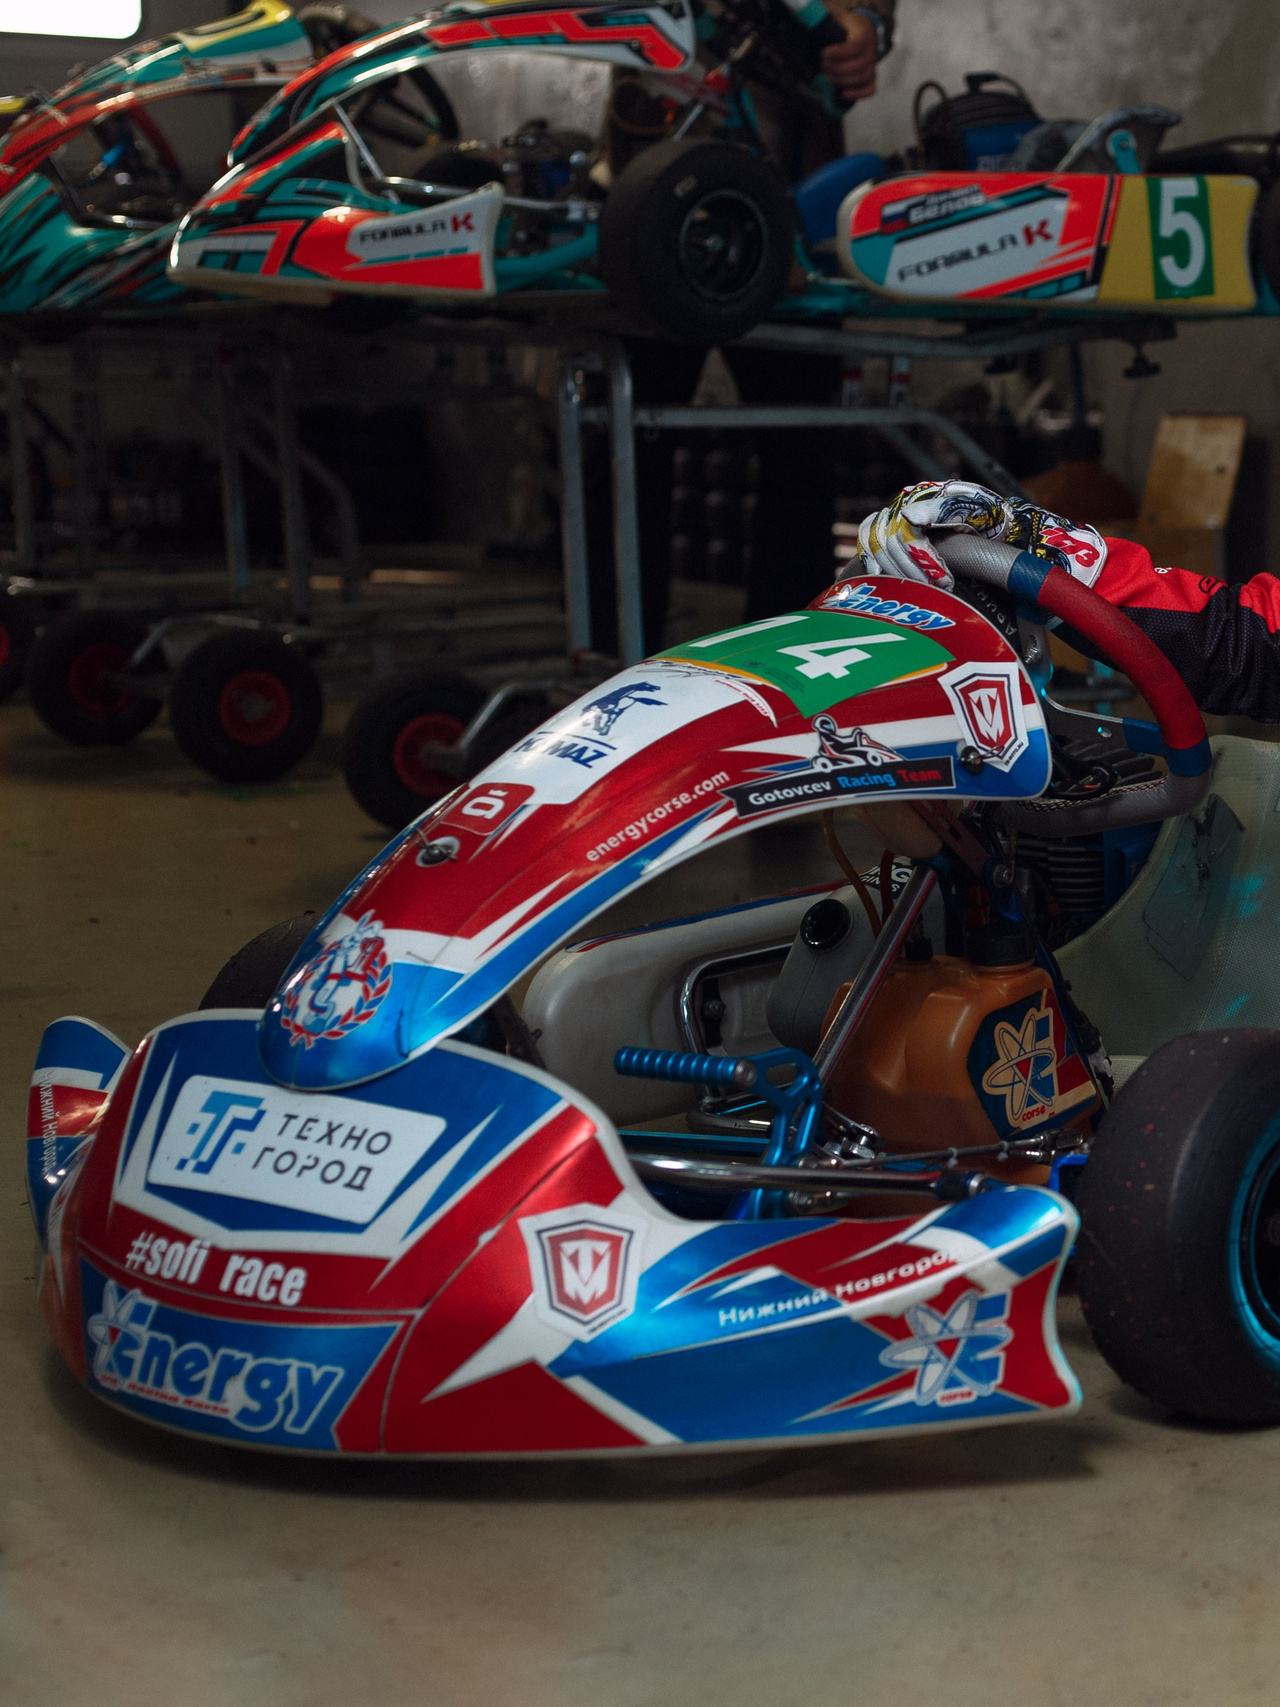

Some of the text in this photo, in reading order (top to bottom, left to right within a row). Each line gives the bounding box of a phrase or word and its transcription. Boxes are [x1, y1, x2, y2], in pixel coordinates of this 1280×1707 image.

[359, 211, 475, 245] FORMULA K
[897, 217, 1053, 283] FORMULA K
[1158, 177, 1206, 288] 5
[832, 584, 956, 631] Energy
[513, 738, 608, 769] KMAZ
[748, 767, 942, 808] Gotovcev Racing Team
[585, 768, 731, 862] energycorse.com
[275, 1113, 393, 1156] ТЕХНО
[1021, 1105, 1046, 1122] corse
[251, 1146, 375, 1192] ГОРОД
[124, 1230, 308, 1308] #sofi race
[717, 1286, 830, 1328] Нижний
[104, 1300, 345, 1435] Energy
